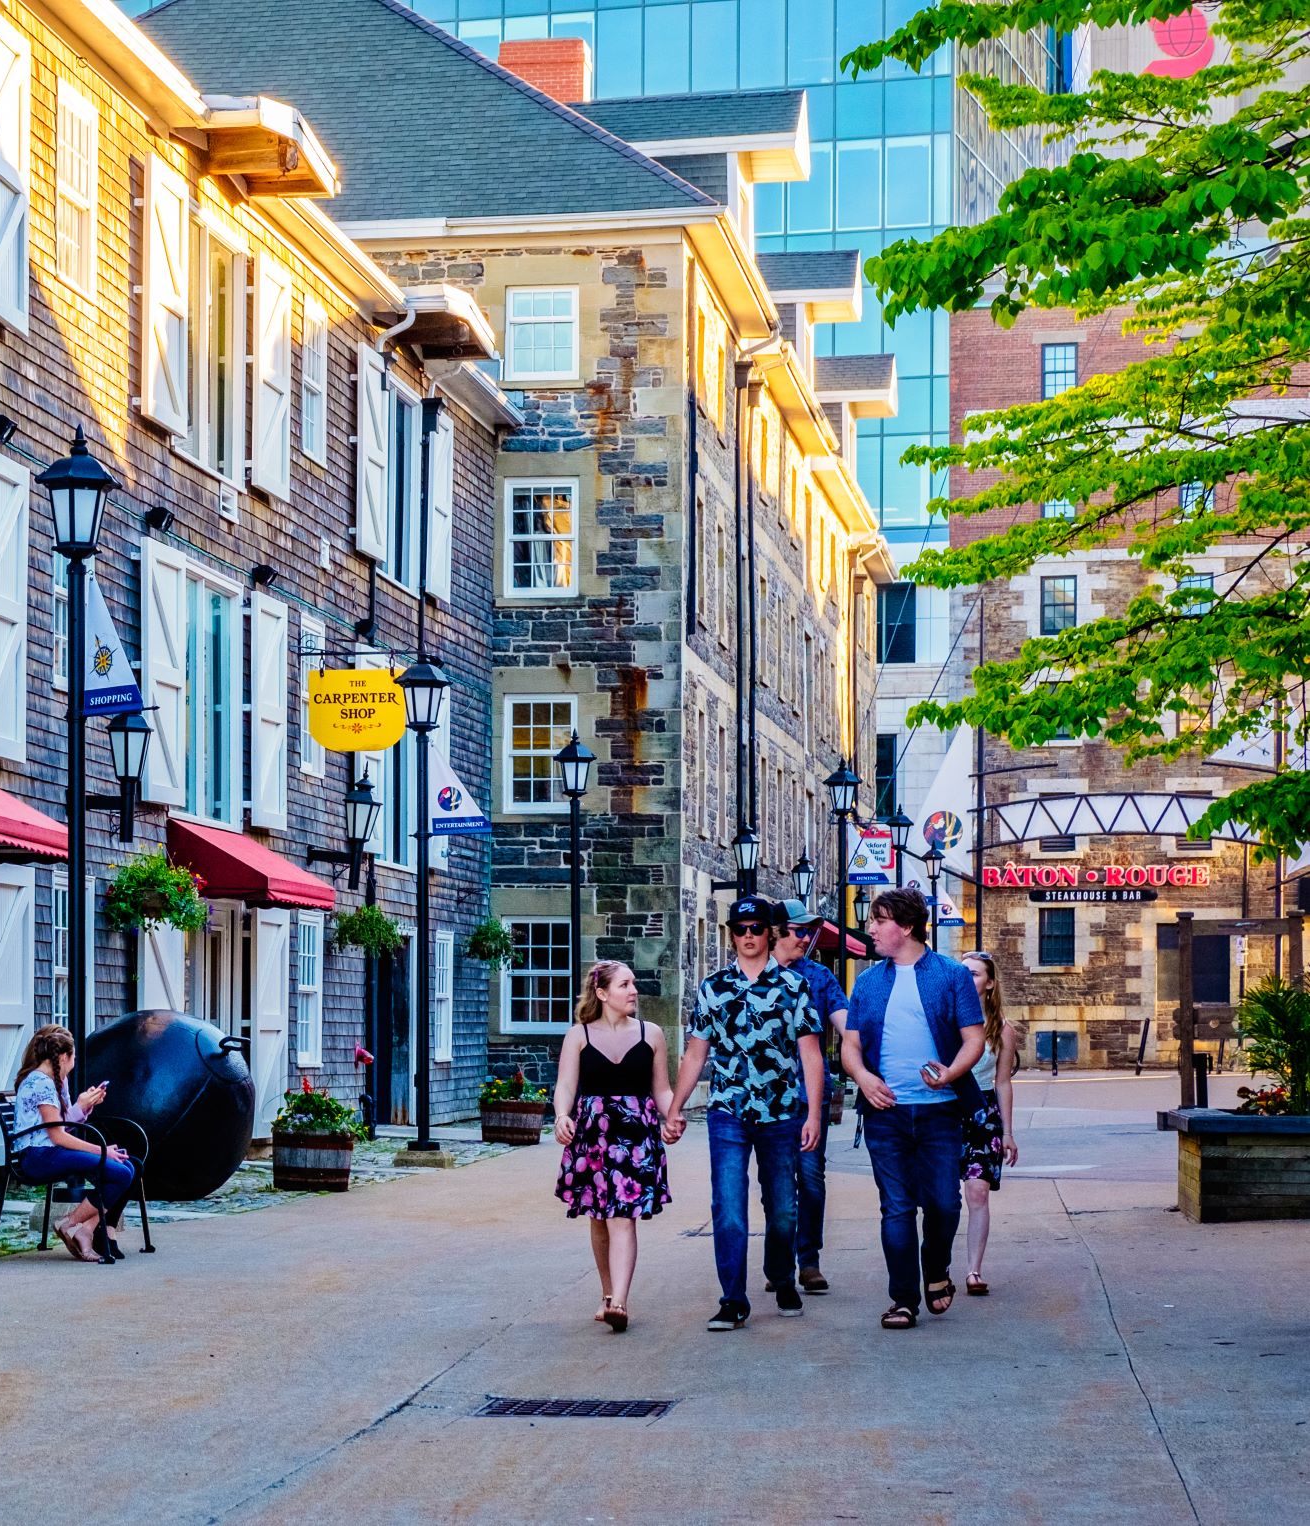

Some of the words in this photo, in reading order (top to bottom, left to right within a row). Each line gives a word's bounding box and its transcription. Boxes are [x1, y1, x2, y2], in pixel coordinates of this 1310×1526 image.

[90, 692, 133, 706] SHOPPING
[313, 692, 400, 706] CARPENTER
[340, 708, 376, 720] SHOP
[435, 821, 485, 829] ENTERTAINMENT
[982, 861, 1079, 888] BÂTON
[1104, 864, 1210, 888] ROUGE
[1045, 890, 1107, 901] STEAKHOUSE
[1111, 890, 1117, 900] &
[1122, 890, 1141, 901] BAR
